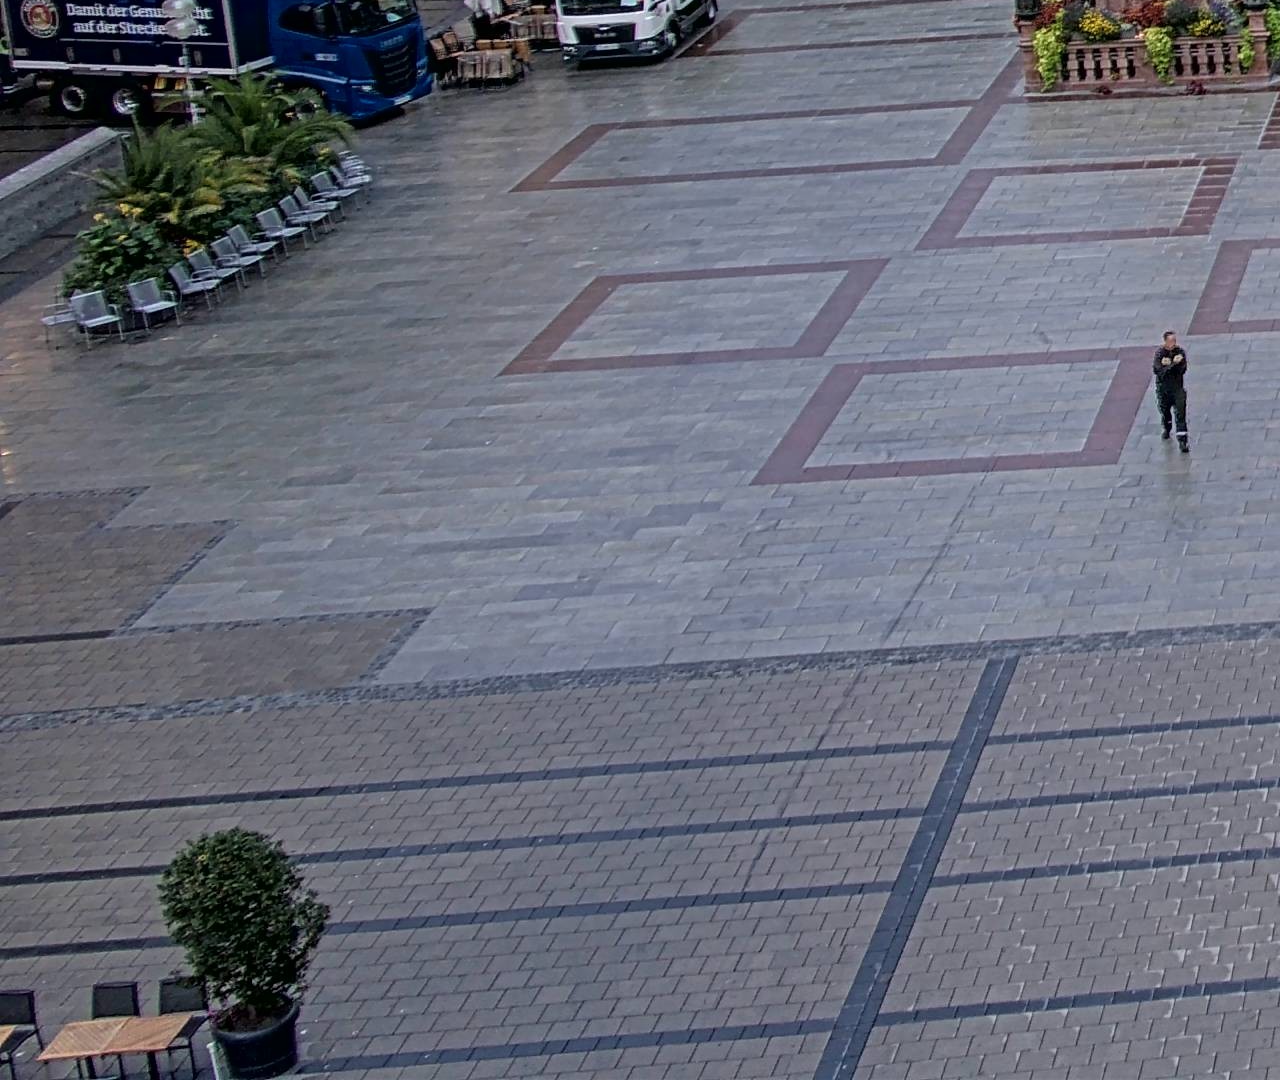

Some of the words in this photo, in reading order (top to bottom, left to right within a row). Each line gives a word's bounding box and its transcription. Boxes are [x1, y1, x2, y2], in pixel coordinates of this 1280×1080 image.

[66, 3, 105, 17] Damit
[107, 4, 128, 17] der
[73, 20, 96, 33] auf
[97, 21, 118, 34] der
